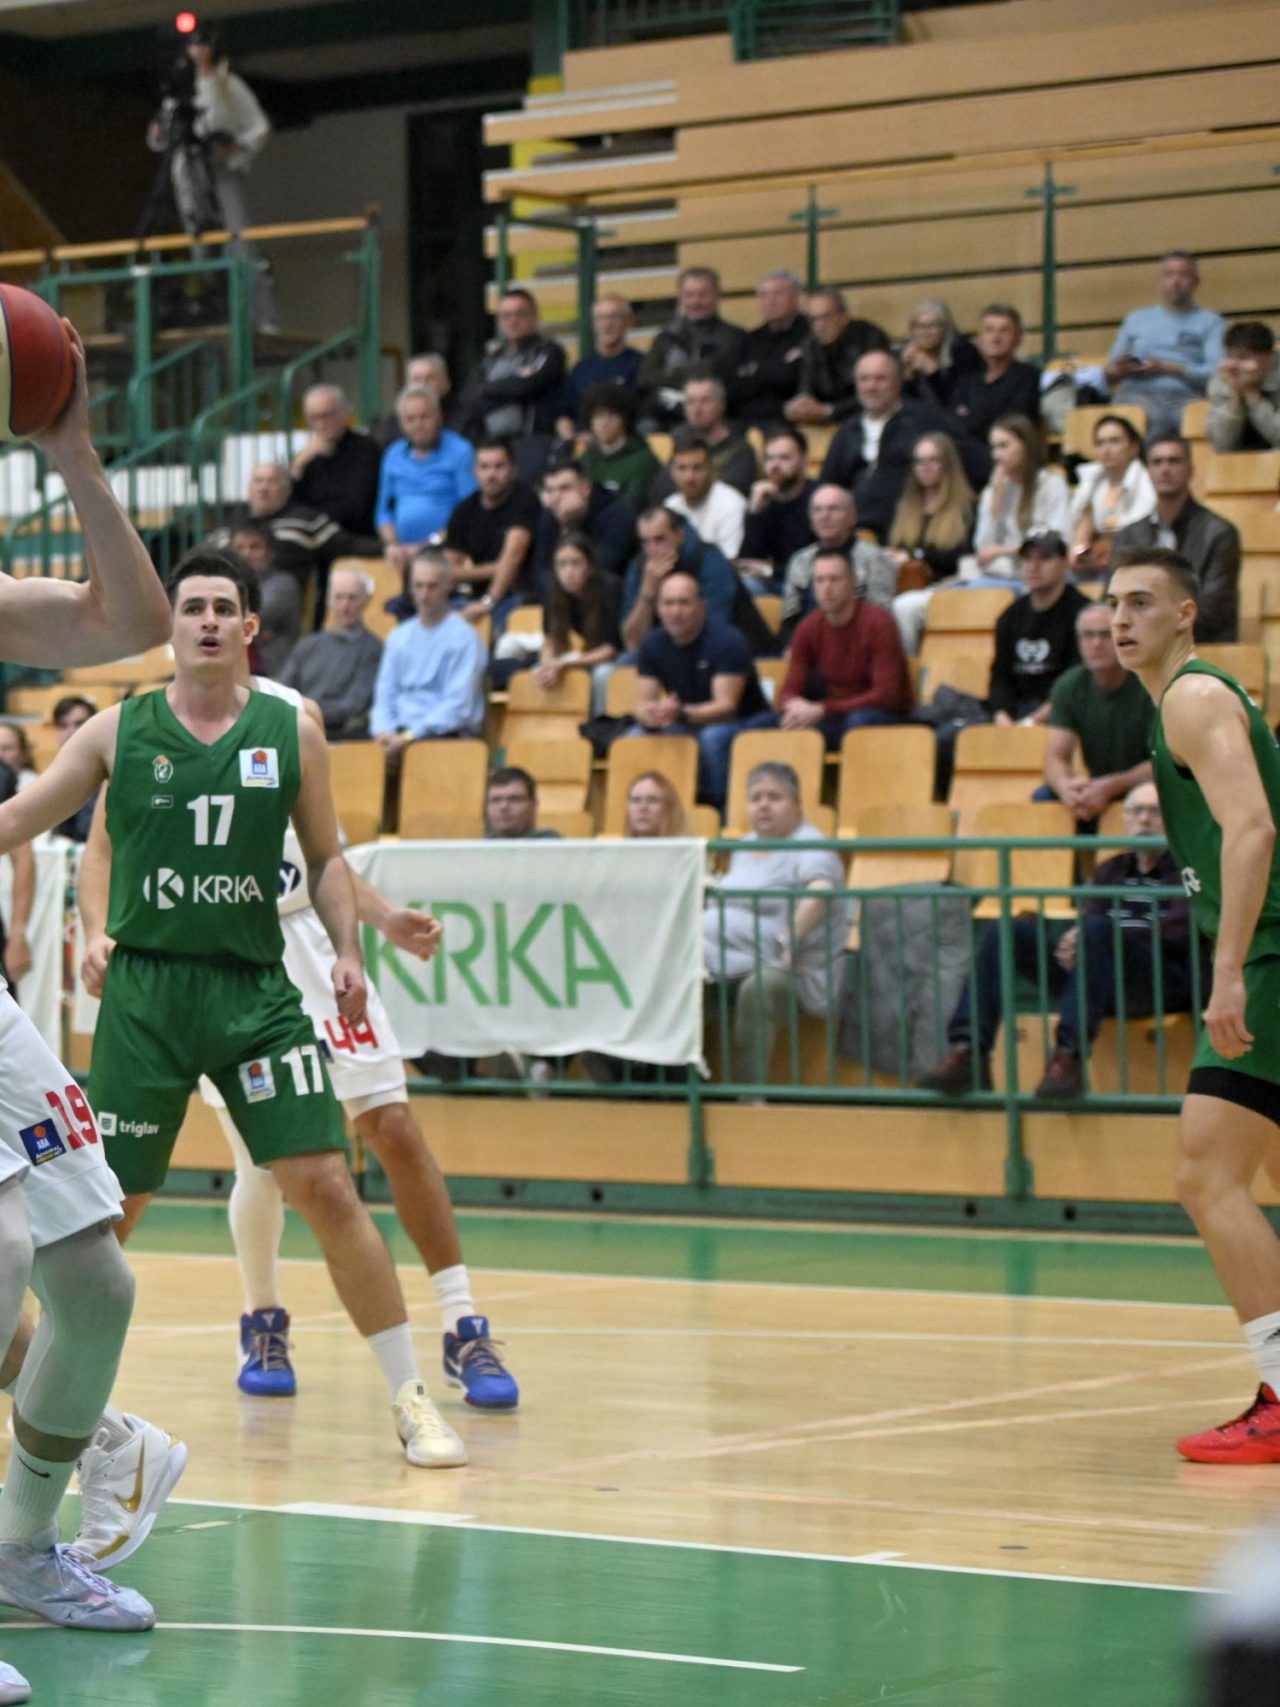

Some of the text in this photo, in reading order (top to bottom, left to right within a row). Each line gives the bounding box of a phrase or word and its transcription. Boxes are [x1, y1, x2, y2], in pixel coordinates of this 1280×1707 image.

[187, 795, 235, 845] 17
[193, 875, 264, 904] KRKA
[362, 902, 633, 1008] KRKA
[324, 1014, 379, 1054] 44
[280, 1045, 325, 1096] 17
[45, 1085, 98, 1150] 19
[120, 1120, 160, 1138] triglav
